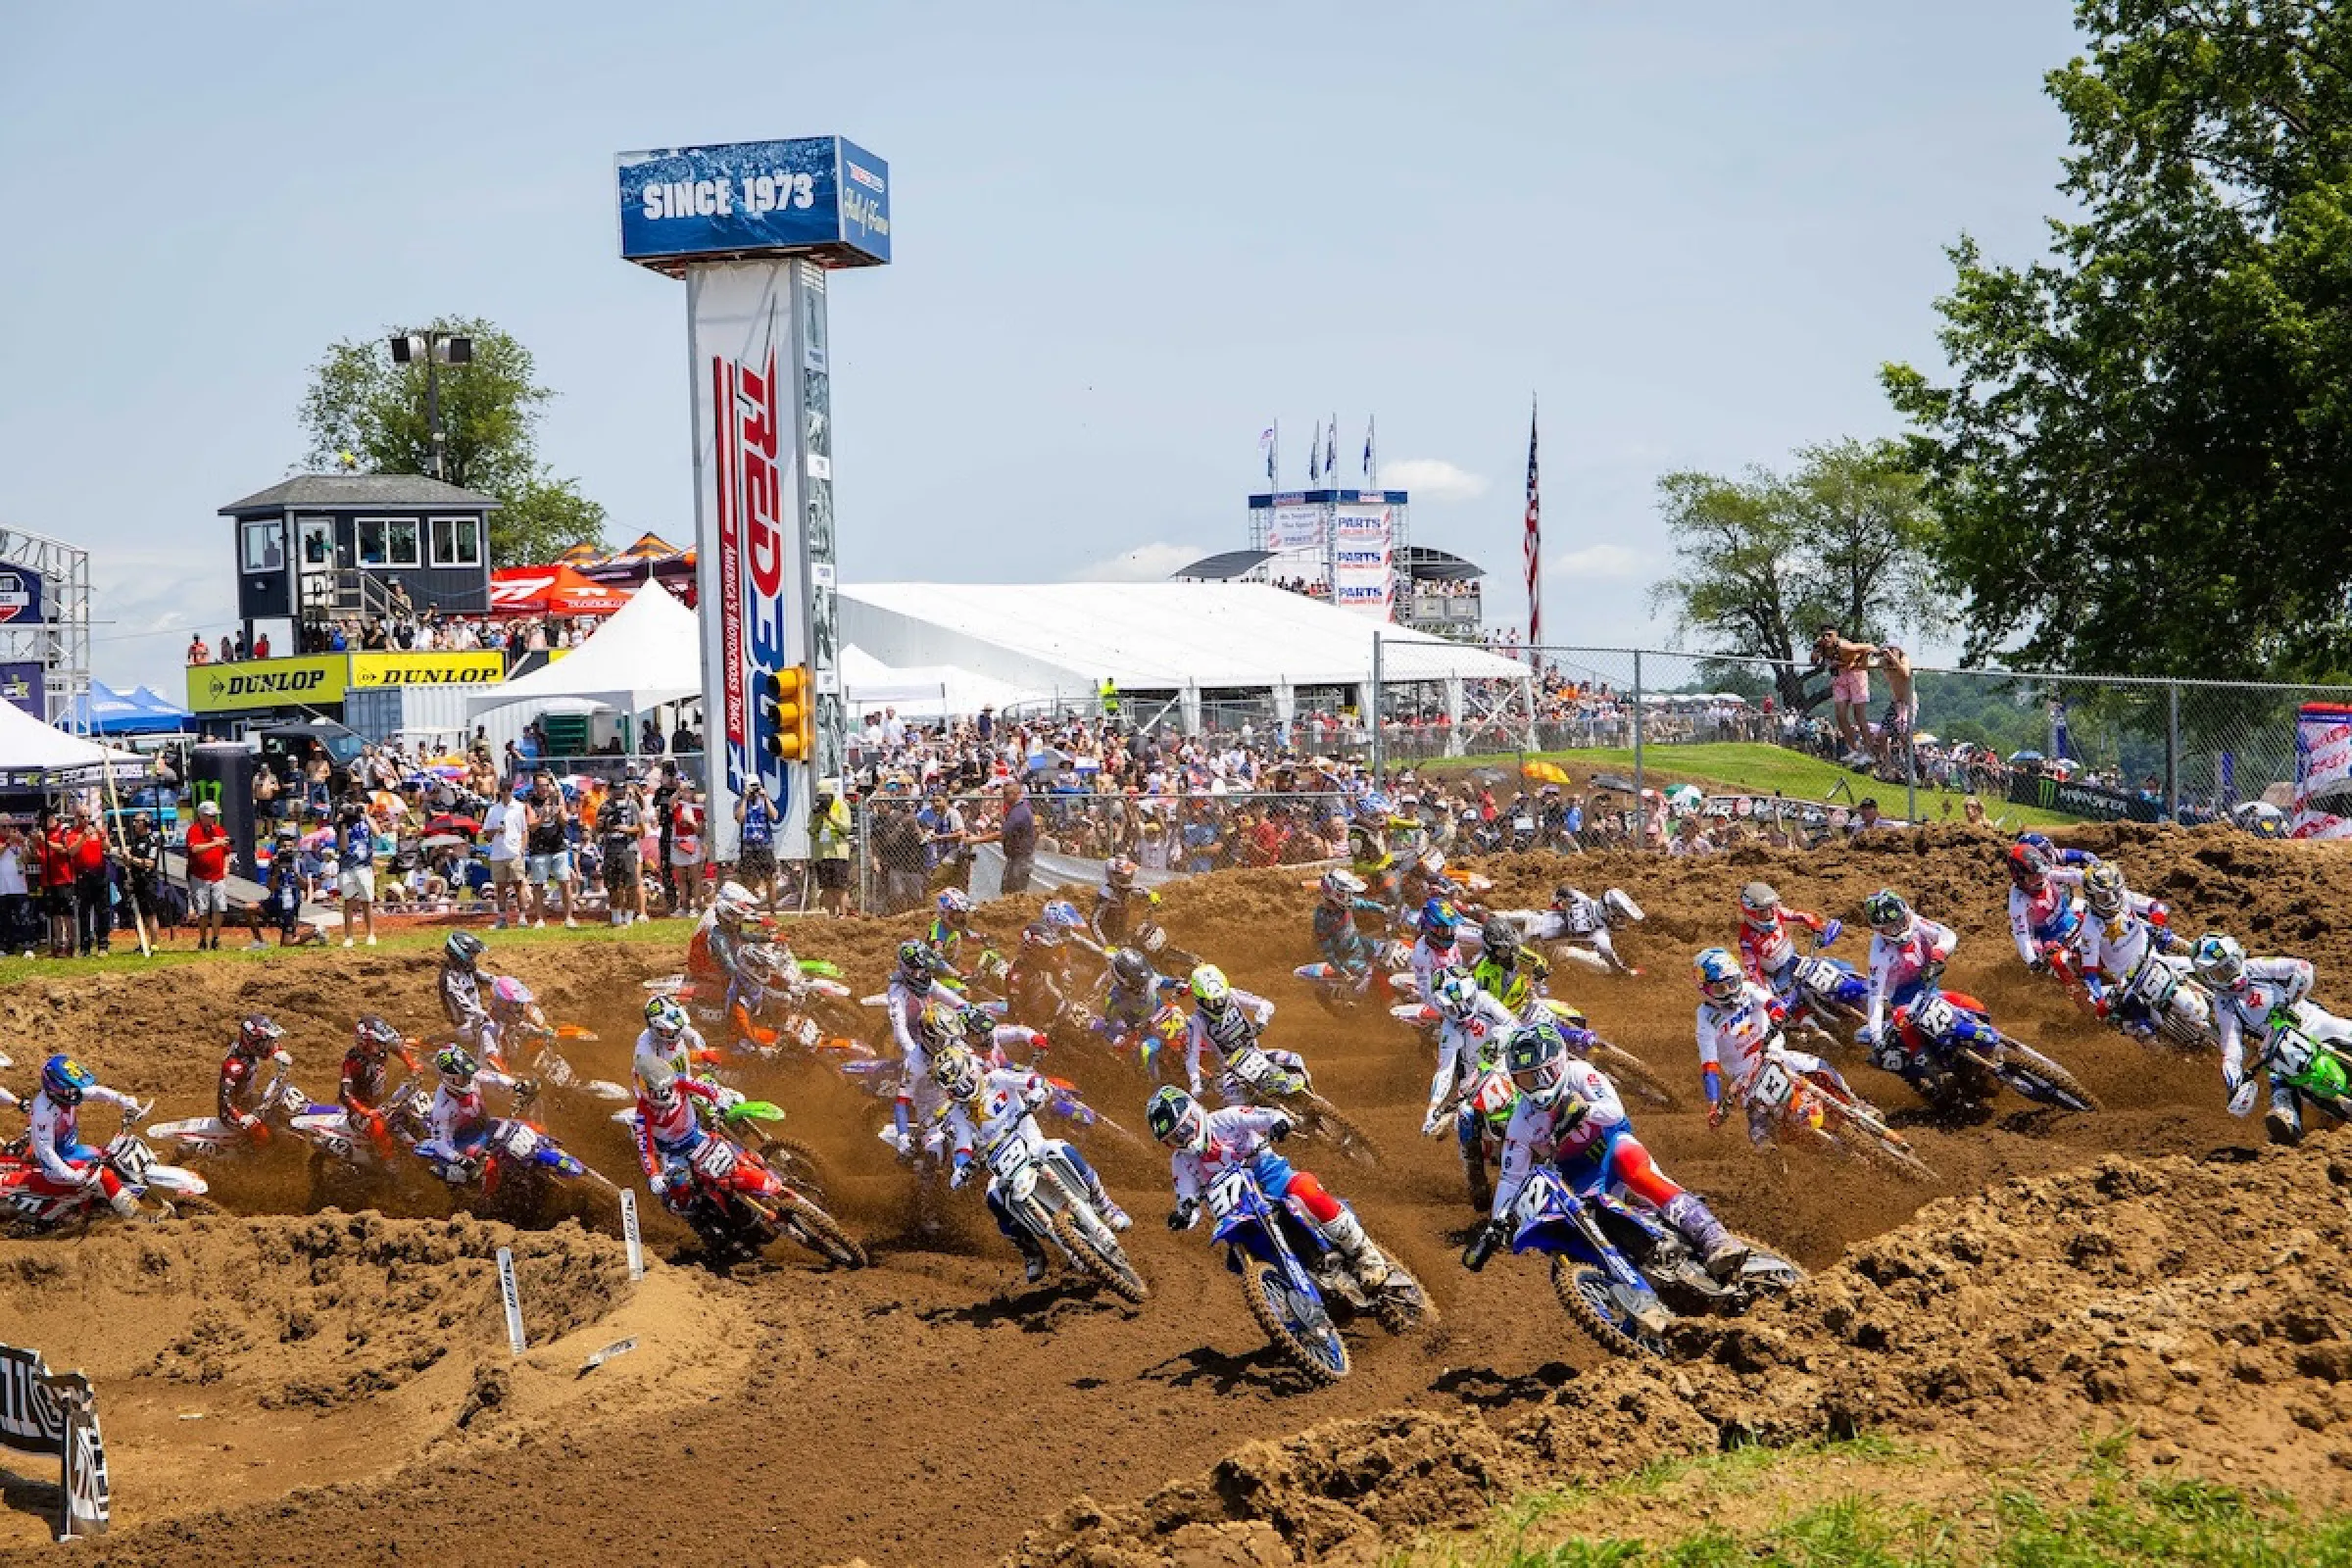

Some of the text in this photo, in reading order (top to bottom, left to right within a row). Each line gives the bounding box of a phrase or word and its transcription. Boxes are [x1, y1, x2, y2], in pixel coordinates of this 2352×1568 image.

[643, 180, 732, 220] SINCE
[741, 172, 814, 213] 1973
[1338, 517, 1381, 528] PARTS
[1338, 552, 1381, 562] PARTS
[1338, 587, 1381, 597] PARTS
[227, 669, 325, 696] DUNLOP
[381, 667, 499, 684] DUNLOP
[1921, 1000, 1954, 1035] 25
[1754, 1063, 1789, 1104] 13
[1206, 1170, 1244, 1218] 37
